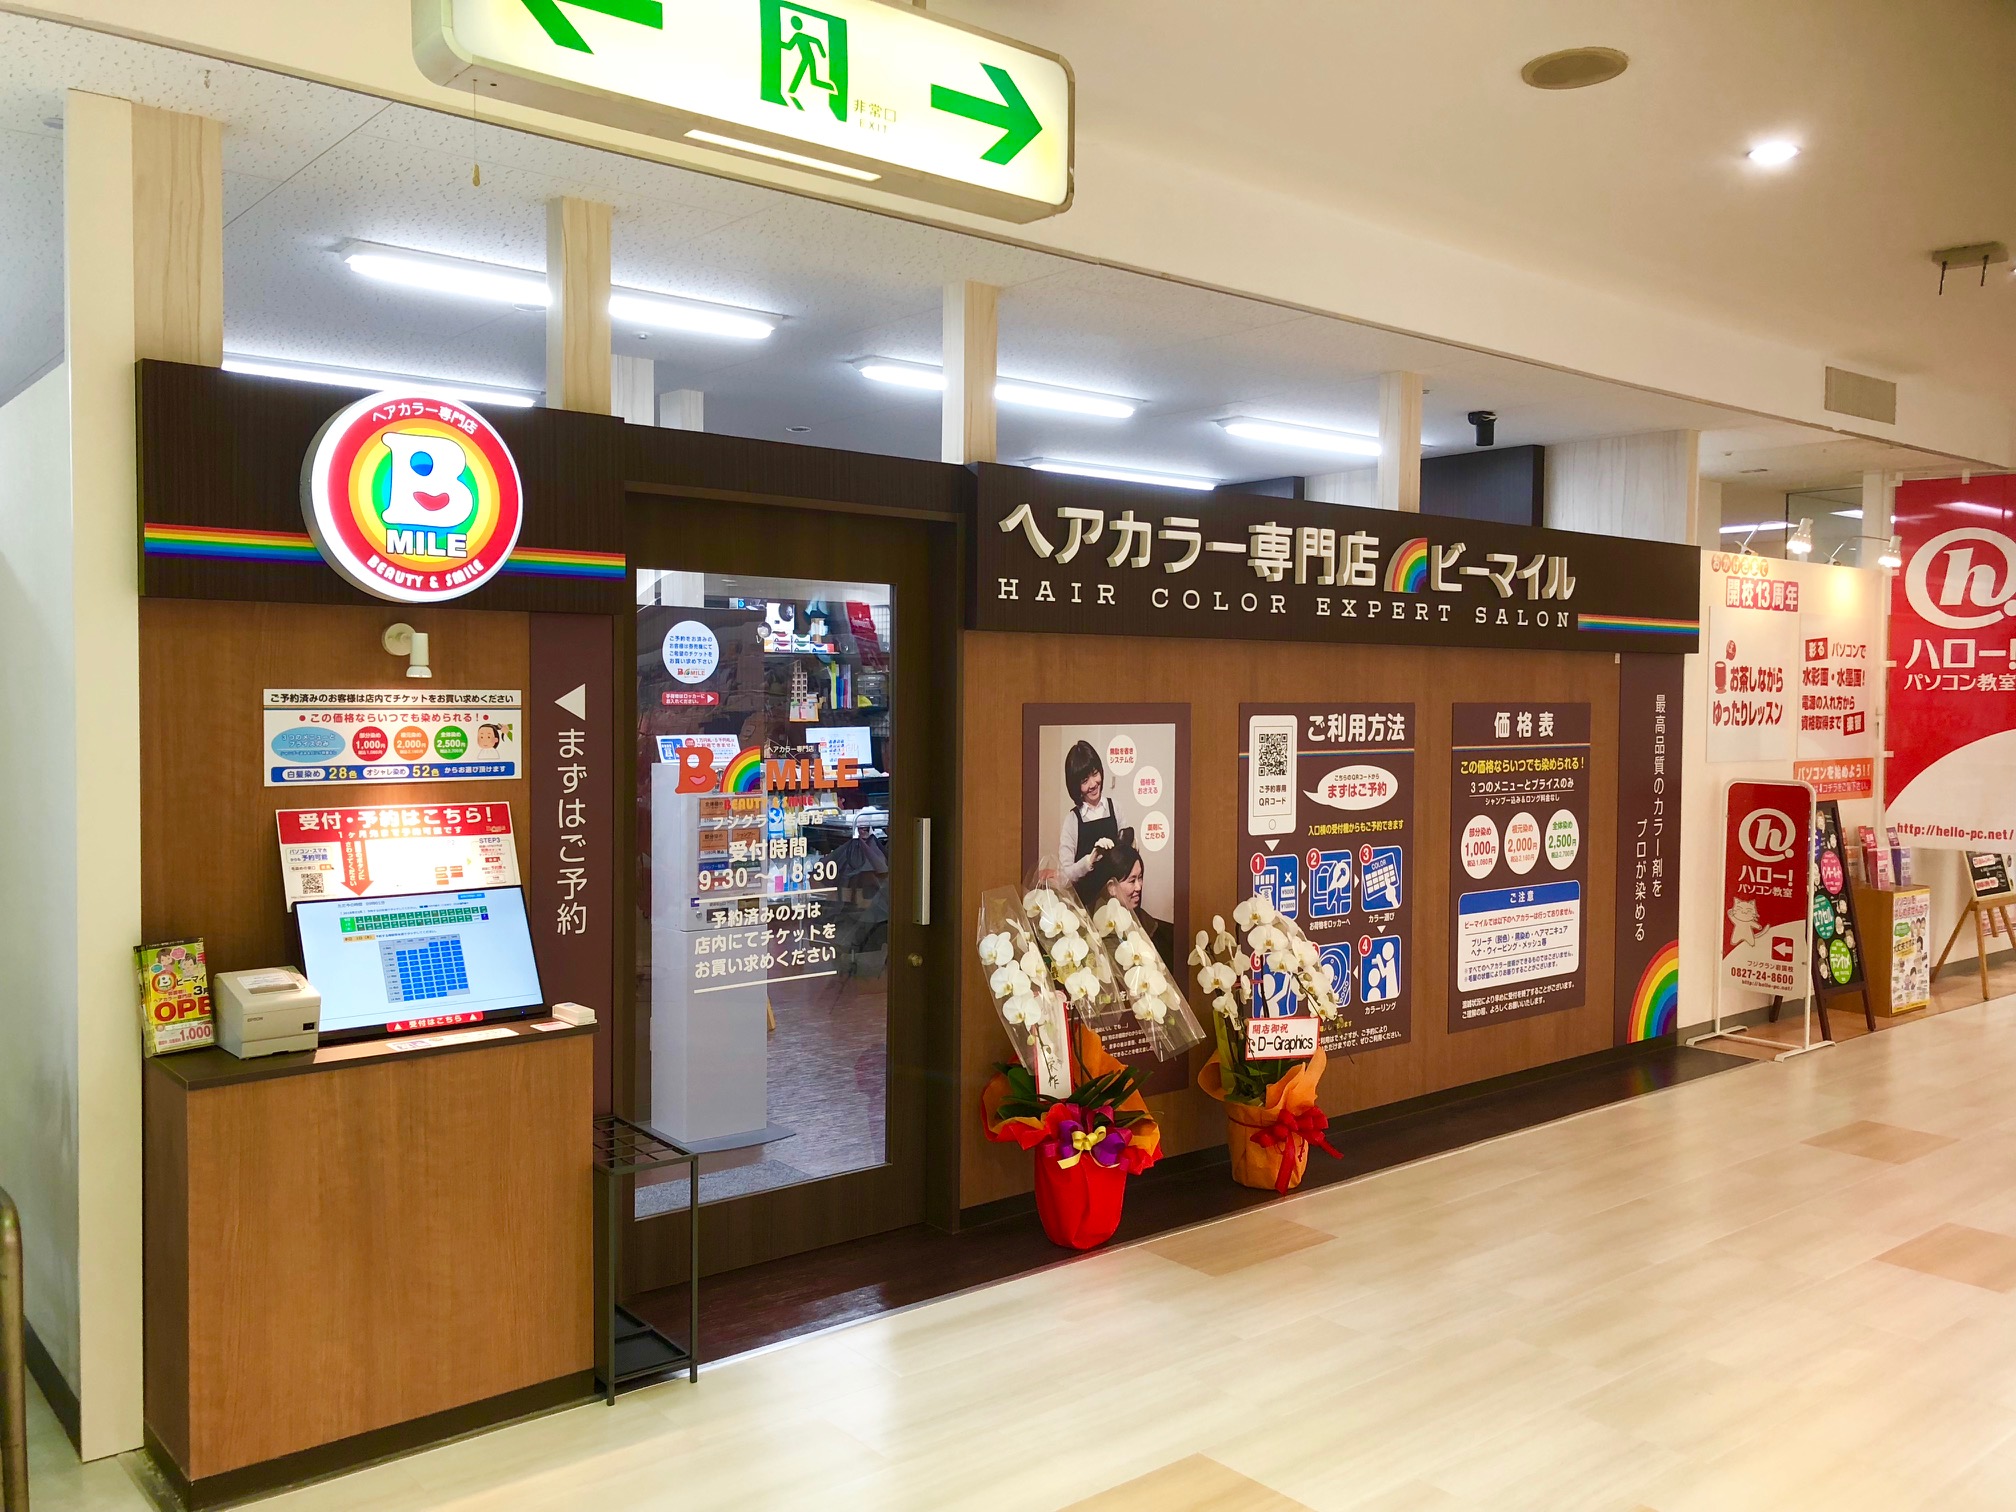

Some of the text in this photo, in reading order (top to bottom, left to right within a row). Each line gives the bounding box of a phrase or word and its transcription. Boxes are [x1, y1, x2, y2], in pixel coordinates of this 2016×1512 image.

[854, 99, 897, 122] 非常口
[372, 401, 479, 435] ヘアカラー専門店
[382, 432, 474, 527] B
[386, 529, 467, 558] MILE
[999, 503, 1576, 600] ヘアカラー専門店 ビーマイル
[366, 555, 484, 590] BEAUTY & SMILE
[998, 578, 1571, 628] HAIR COLOR EXPERT SALON
[1726, 577, 1798, 611] 開校13周年
[1809, 641, 1867, 659] 彩る パソコンで
[1730, 666, 1784, 693] お茶しながら
[1903, 673, 2016, 691] パソコン教室
[270, 693, 514, 704] ご予約済みのお客様は店内でチケットをお買い求めください
[1713, 700, 1783, 726] ゆったりレッスン
[1307, 713, 1405, 742] ご利用方法
[1494, 711, 1554, 739] 価格表
[767, 744, 814, 754] ヘアカラー専門店
[675, 746, 858, 795] B MILE
[1259, 785, 1287, 793] ご予約専用
[1327, 782, 1387, 799] まずはご予約
[1652, 694, 1666, 898] 最高品質のカラー剤を
[724, 797, 768, 811] BEAUTY
[783, 796, 814, 807] SMILE
[1259, 797, 1287, 806] QRコード
[478, 837, 503, 845] STEP3
[557, 728, 588, 936] まずはご予約
[1469, 827, 1492, 838] 部分染め
[1548, 833, 1577, 849] 2,500円
[1897, 823, 2015, 841] http://hello-pc.net/
[729, 837, 807, 863] 受付時間
[1465, 841, 1496, 857] 1,000円
[1507, 837, 1538, 853] 2,000円
[1371, 859, 1387, 870] COLOR
[1634, 818, 1648, 941] プロが染める
[1738, 865, 1793, 887] ハロー!
[1510, 890, 1535, 903] ご注意
[1738, 884, 1793, 898] パソコン教室
[711, 902, 821, 929] 予約済みの方は
[695, 923, 836, 955] 店内にてチケットを
[695, 947, 836, 979] お買い求めください
[1731, 967, 1794, 986] 0827-24-8600
[1364, 1001, 1397, 1015] カラーリング
[409, 1015, 463, 1029] 受付はこちら
[1252, 1024, 1289, 1034] 開店御祝
[179, 1025, 212, 1042] 1,000
[1257, 1035, 1313, 1053] D-Graphics
